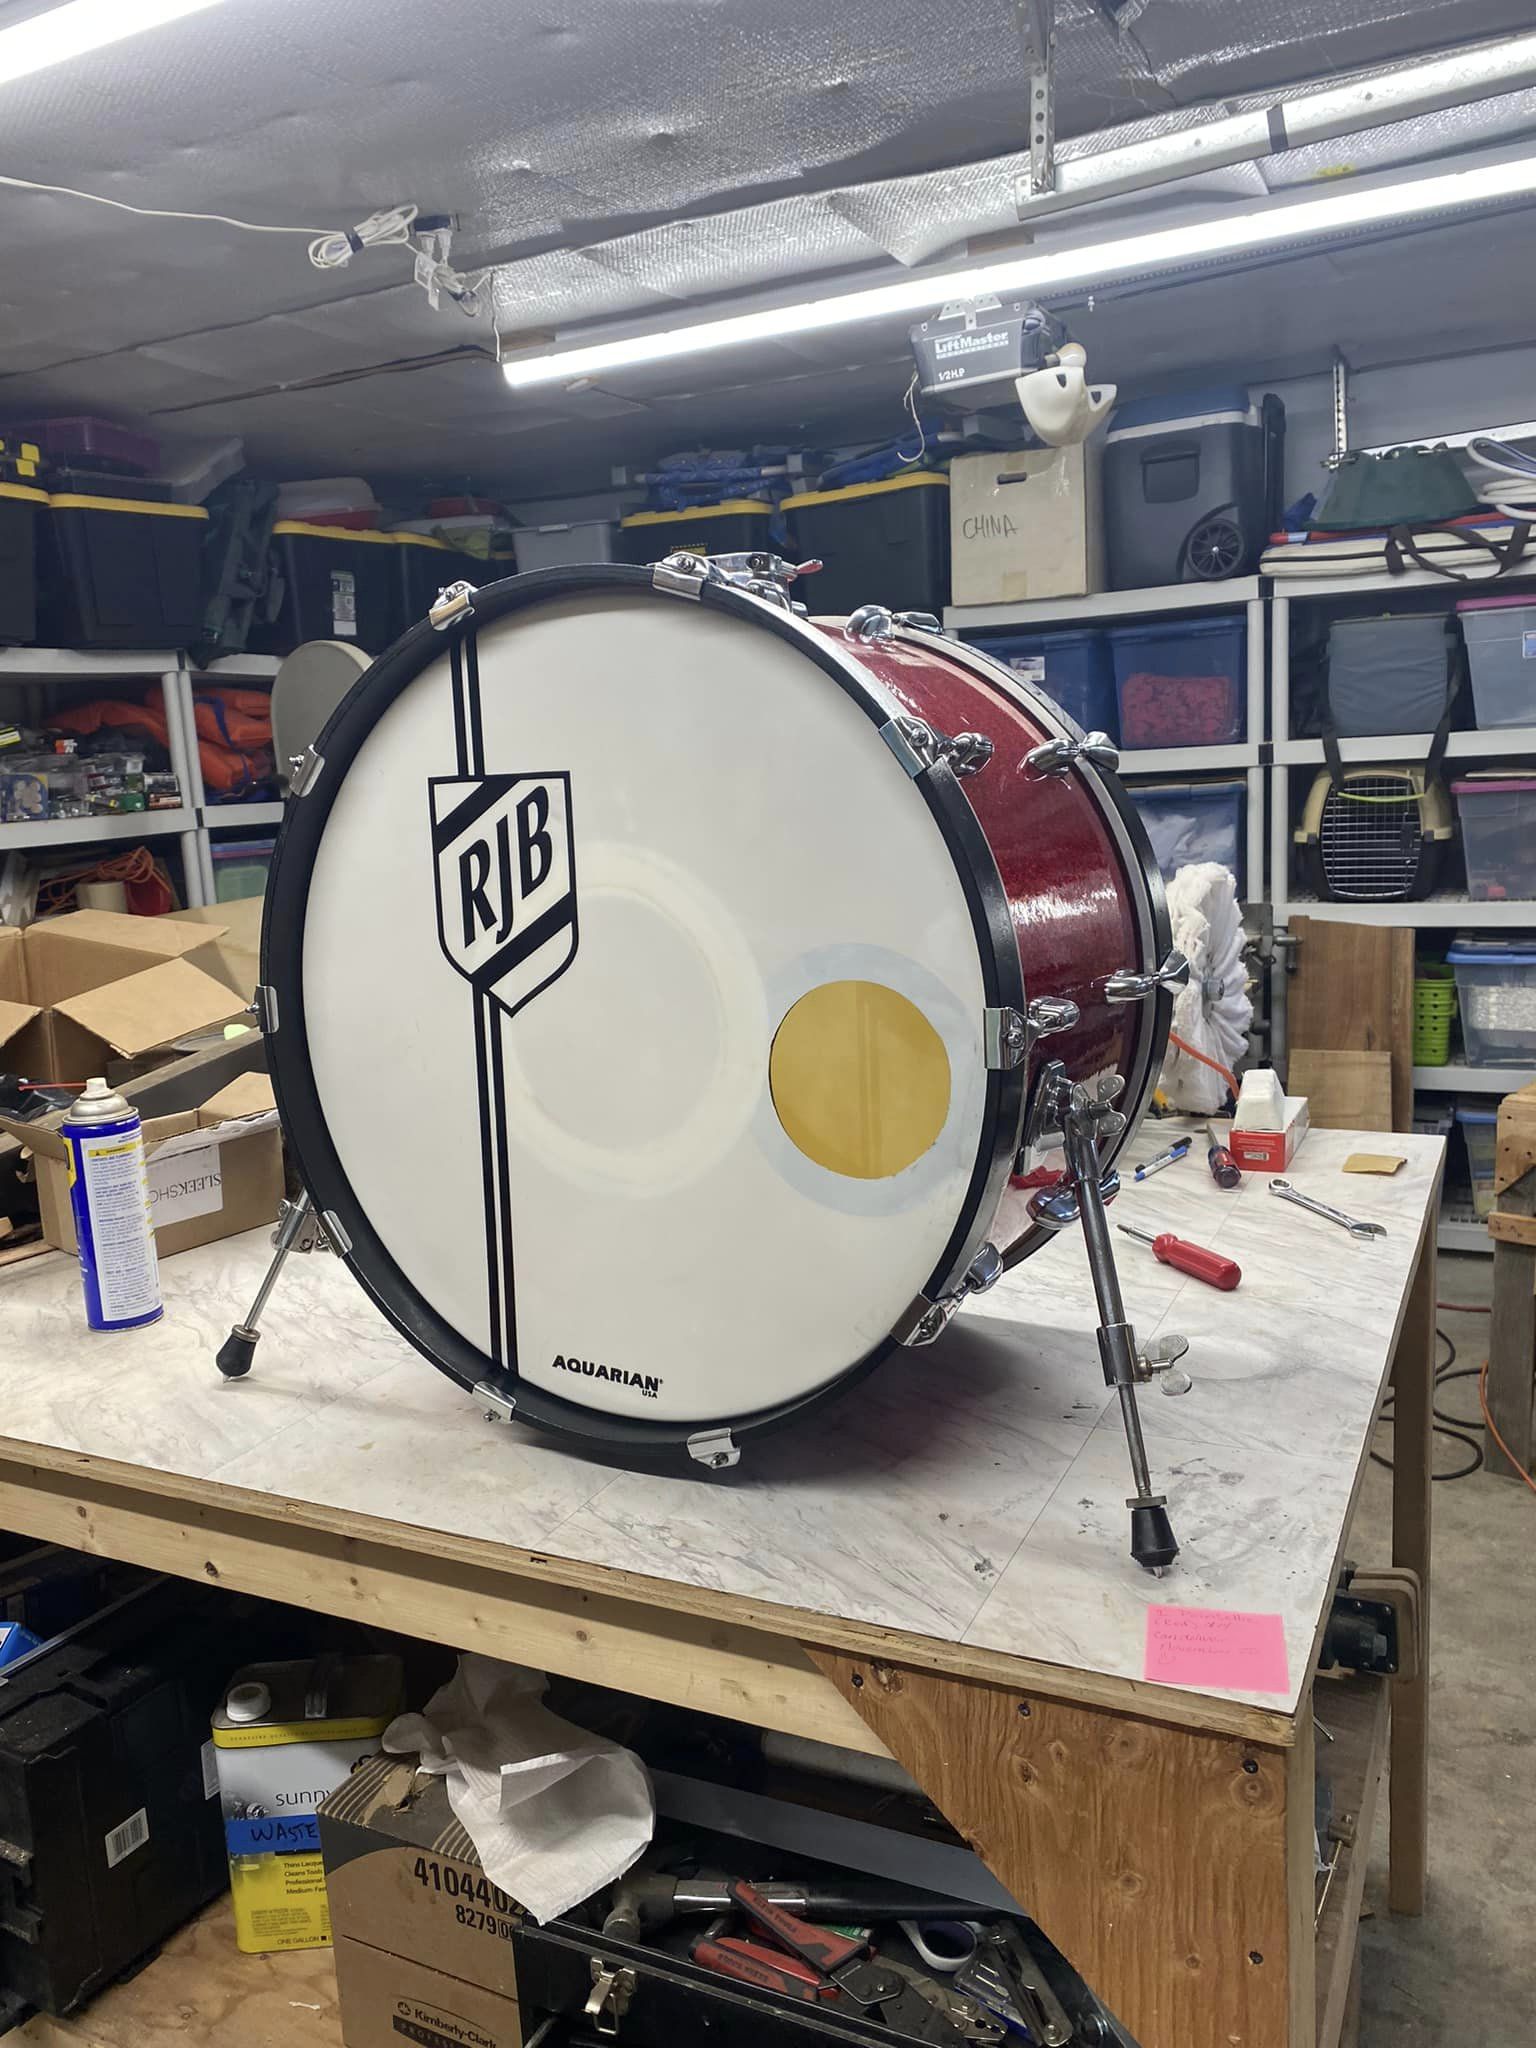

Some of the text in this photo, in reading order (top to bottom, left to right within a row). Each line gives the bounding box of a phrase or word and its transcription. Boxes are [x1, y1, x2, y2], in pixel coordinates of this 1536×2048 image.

[935, 332, 1009, 353] LiftMaster
[962, 514, 1020, 540] CHINA
[458, 785, 553, 949] RJB
[551, 1354, 660, 1392] AQUARIAN
[641, 1389, 658, 1399] USA
[250, 1822, 319, 1842] WASTE
